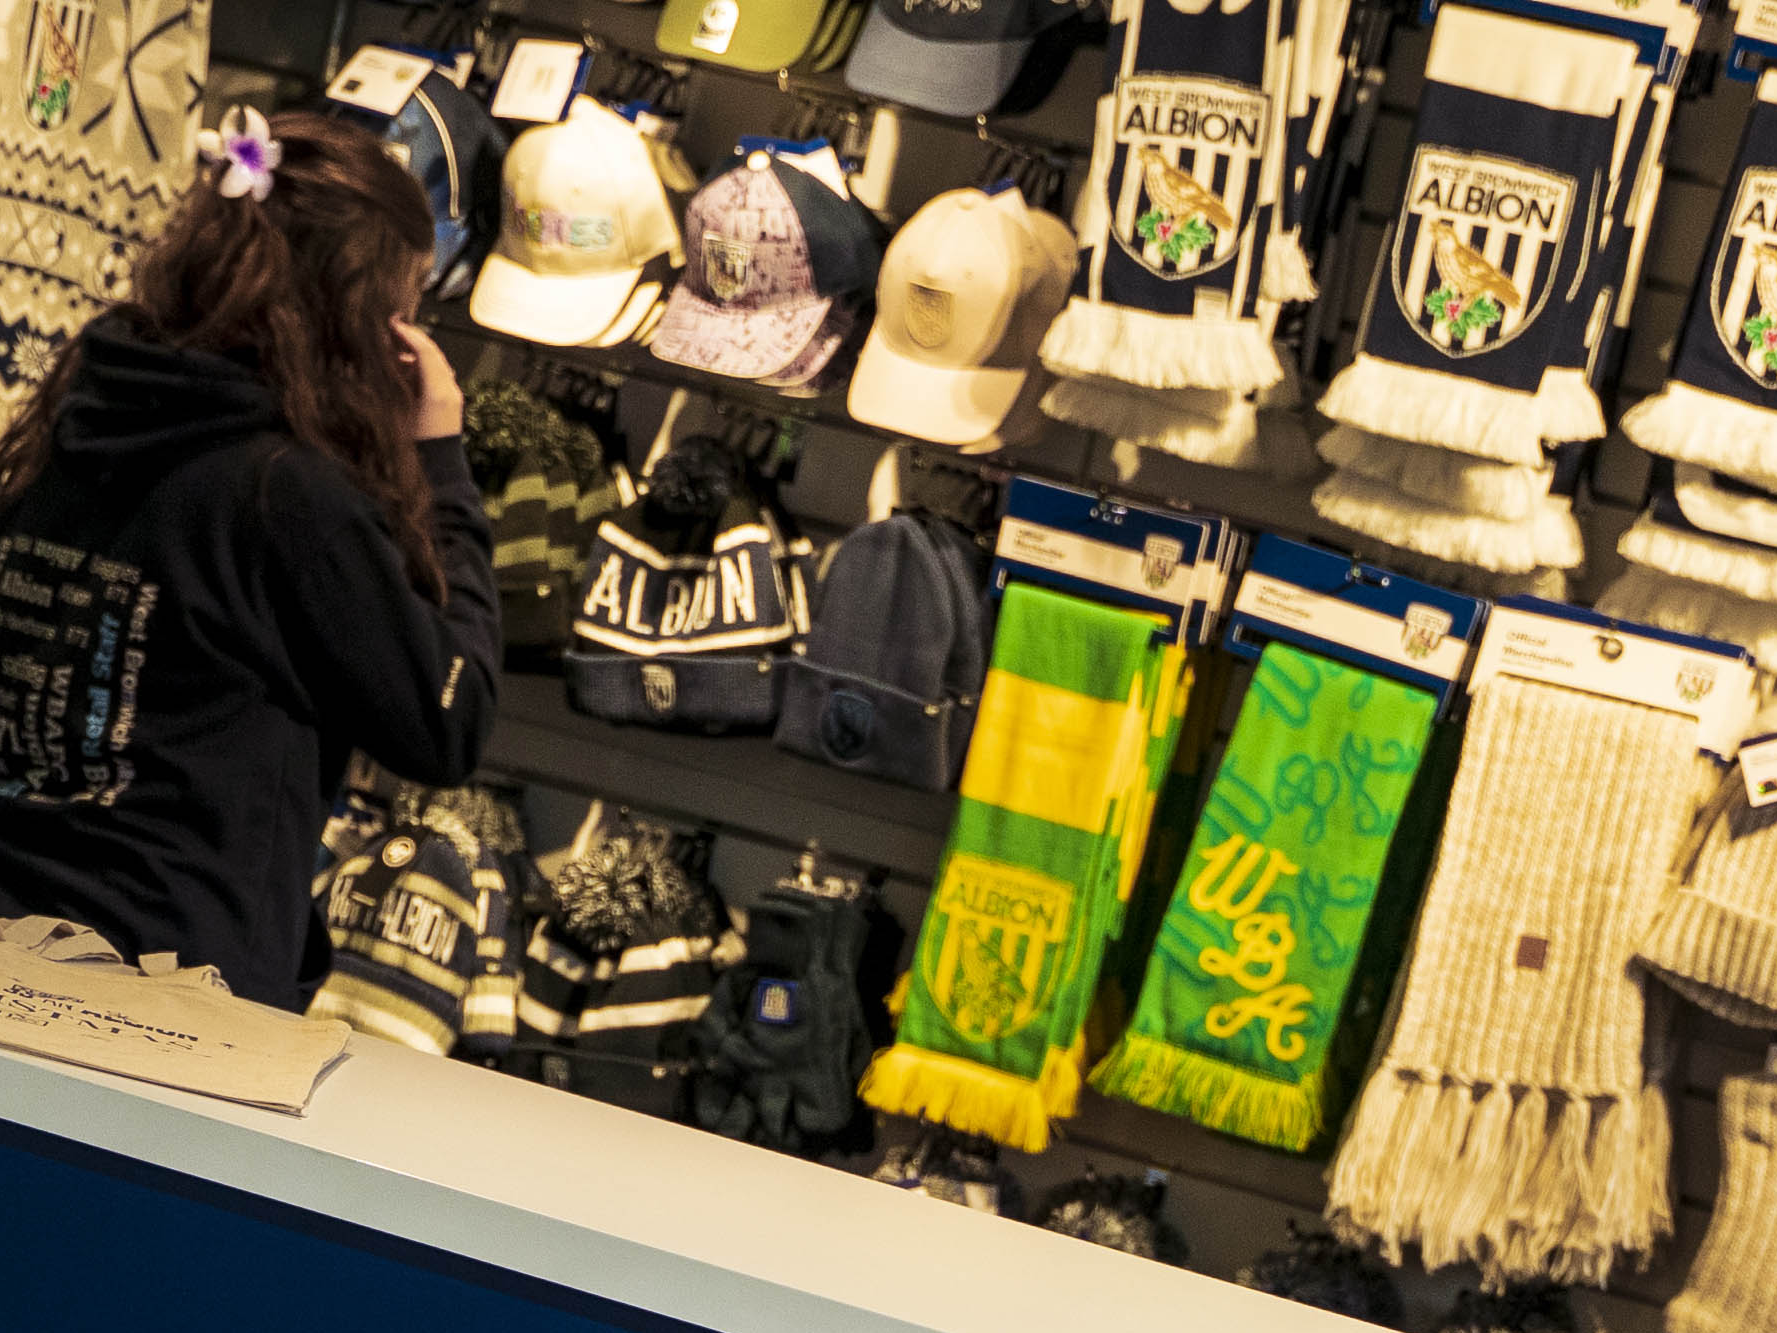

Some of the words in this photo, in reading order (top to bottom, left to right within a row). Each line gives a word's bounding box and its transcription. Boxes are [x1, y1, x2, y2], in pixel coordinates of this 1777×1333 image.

[1124, 104, 1260, 147] ALBION
[1416, 178, 1556, 232] ALBION
[382, 888, 460, 966] ALBION
[947, 882, 1056, 932] ALBION
